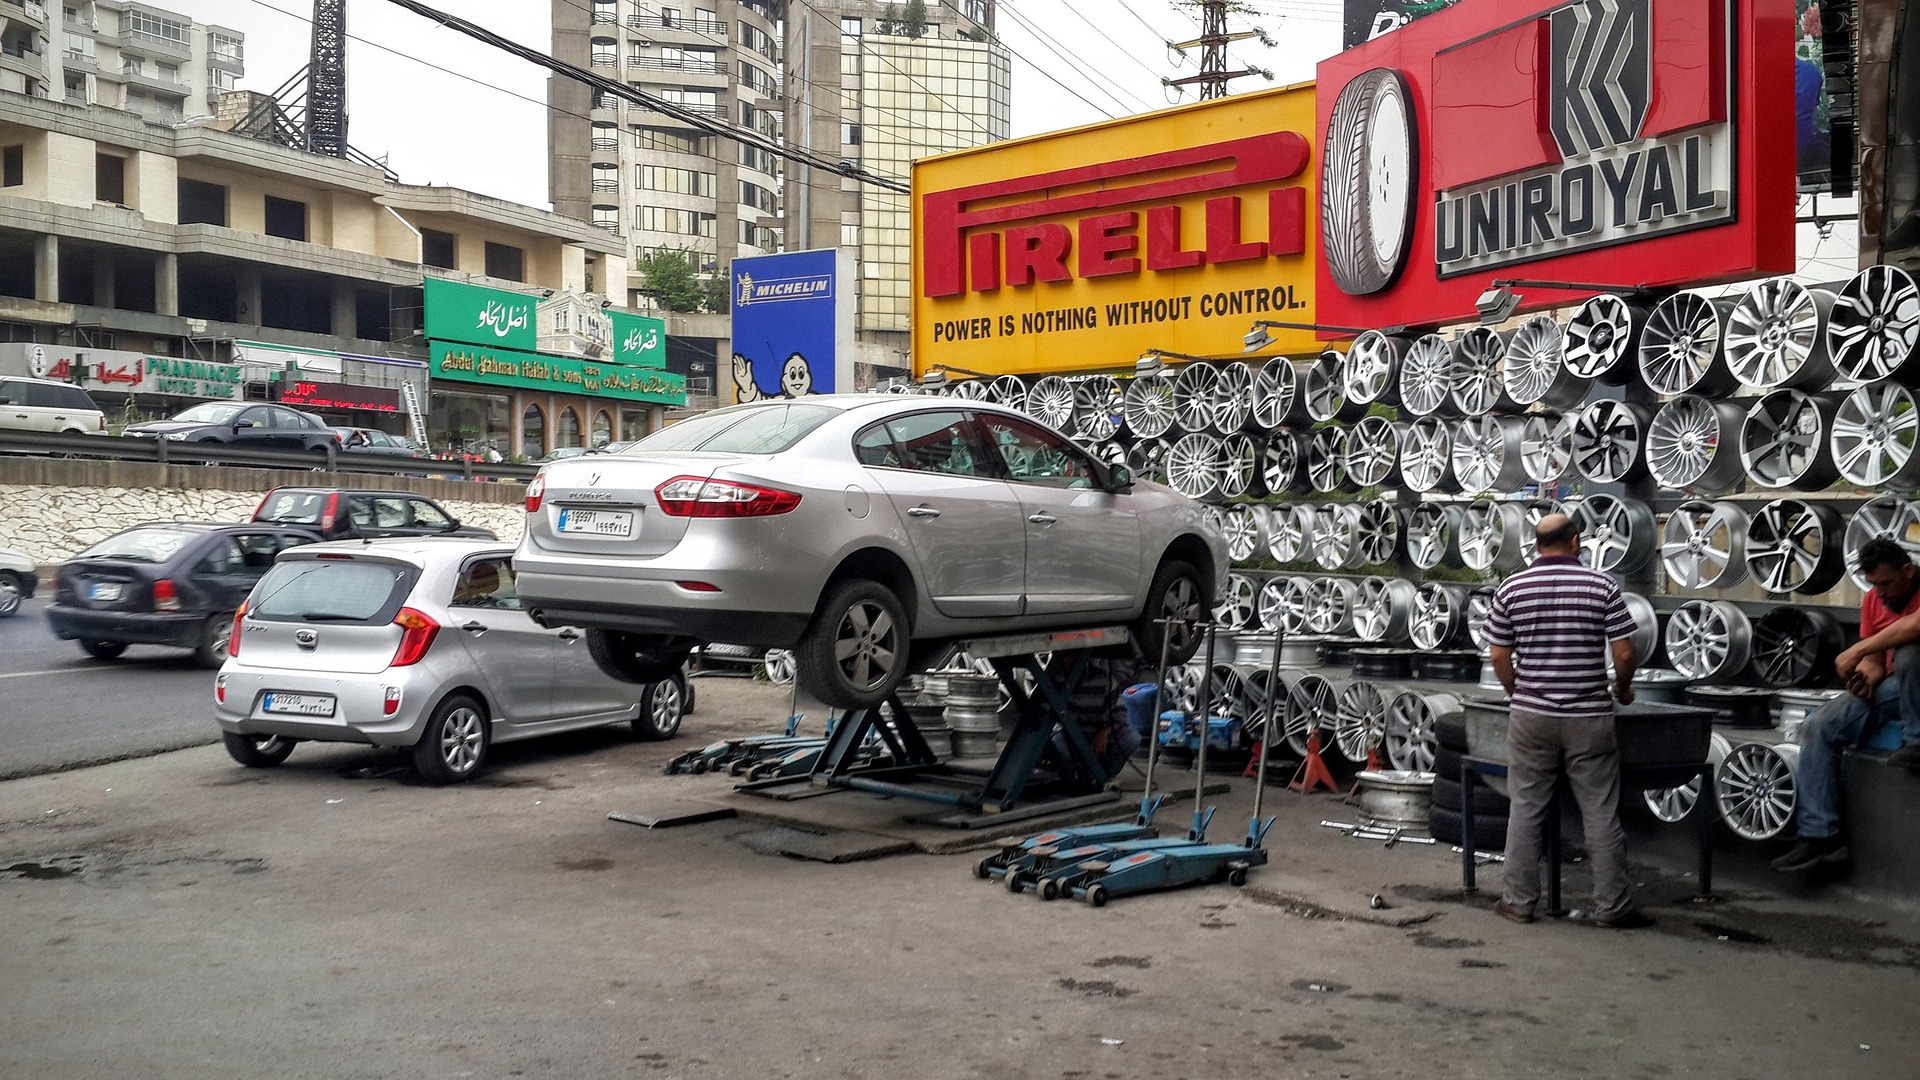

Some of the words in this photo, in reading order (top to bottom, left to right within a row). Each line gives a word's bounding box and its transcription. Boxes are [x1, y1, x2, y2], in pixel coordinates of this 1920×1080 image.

[923, 131, 1310, 298] PIRELLI
[1435, 135, 1728, 264] UNIROYAL
[756, 280, 828, 297] MICHELIN
[933, 317, 991, 343] POWER
[998, 314, 1015, 337] IS
[1022, 306, 1097, 335] NOTHING
[1105, 296, 1192, 327] WITHOUT
[1200, 285, 1307, 317] CONTROL.
[145, 357, 241, 384] PHARMACIE
[441, 351, 474, 372] Abdul
